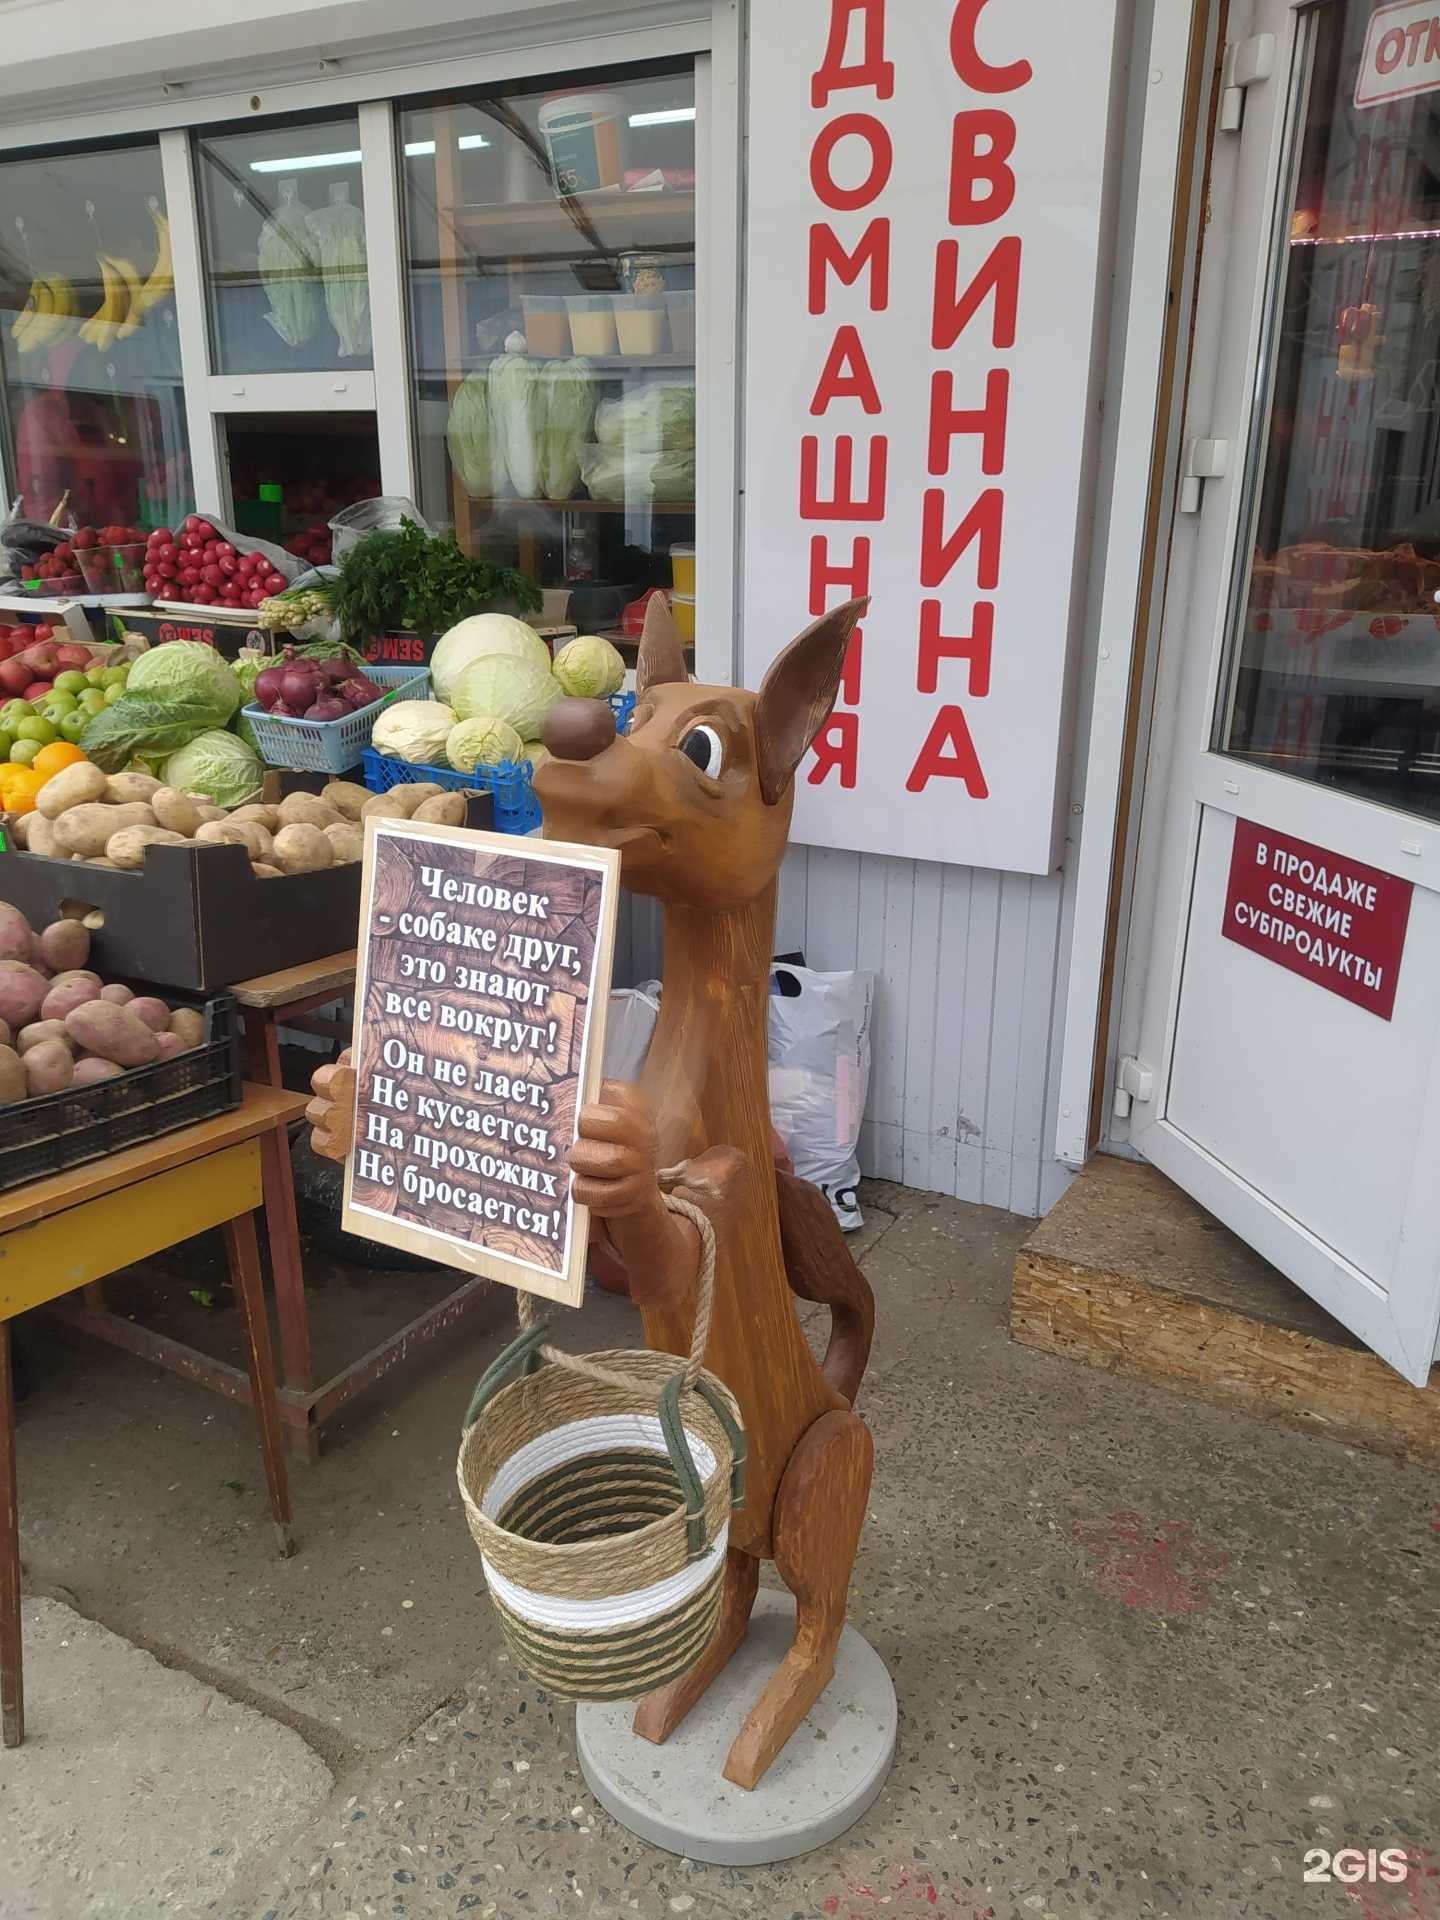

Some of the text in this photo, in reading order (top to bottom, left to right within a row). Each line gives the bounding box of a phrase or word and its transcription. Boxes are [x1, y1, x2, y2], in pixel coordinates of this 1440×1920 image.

[905, 0, 1033, 800] СВИНИНА
[420, 865, 549, 919] Человек
[1257, 842, 1377, 911] В ПРОДАЖЕ
[1268, 883, 1352, 938] СВЕЖИЕ
[398, 910, 497, 954] собаке
[503, 933, 582, 975] друг,
[1235, 902, 1382, 991] СУБПРОДУКТЫ
[400, 952, 550, 1007] это знают
[385, 991, 557, 1053] все вокруг!
[383, 1038, 550, 1115] Он не лает,
[371, 1073, 556, 1160] Не кусается,
[365, 1113, 557, 1199] На прохожих
[358, 1148, 561, 1241] Не бросается!
